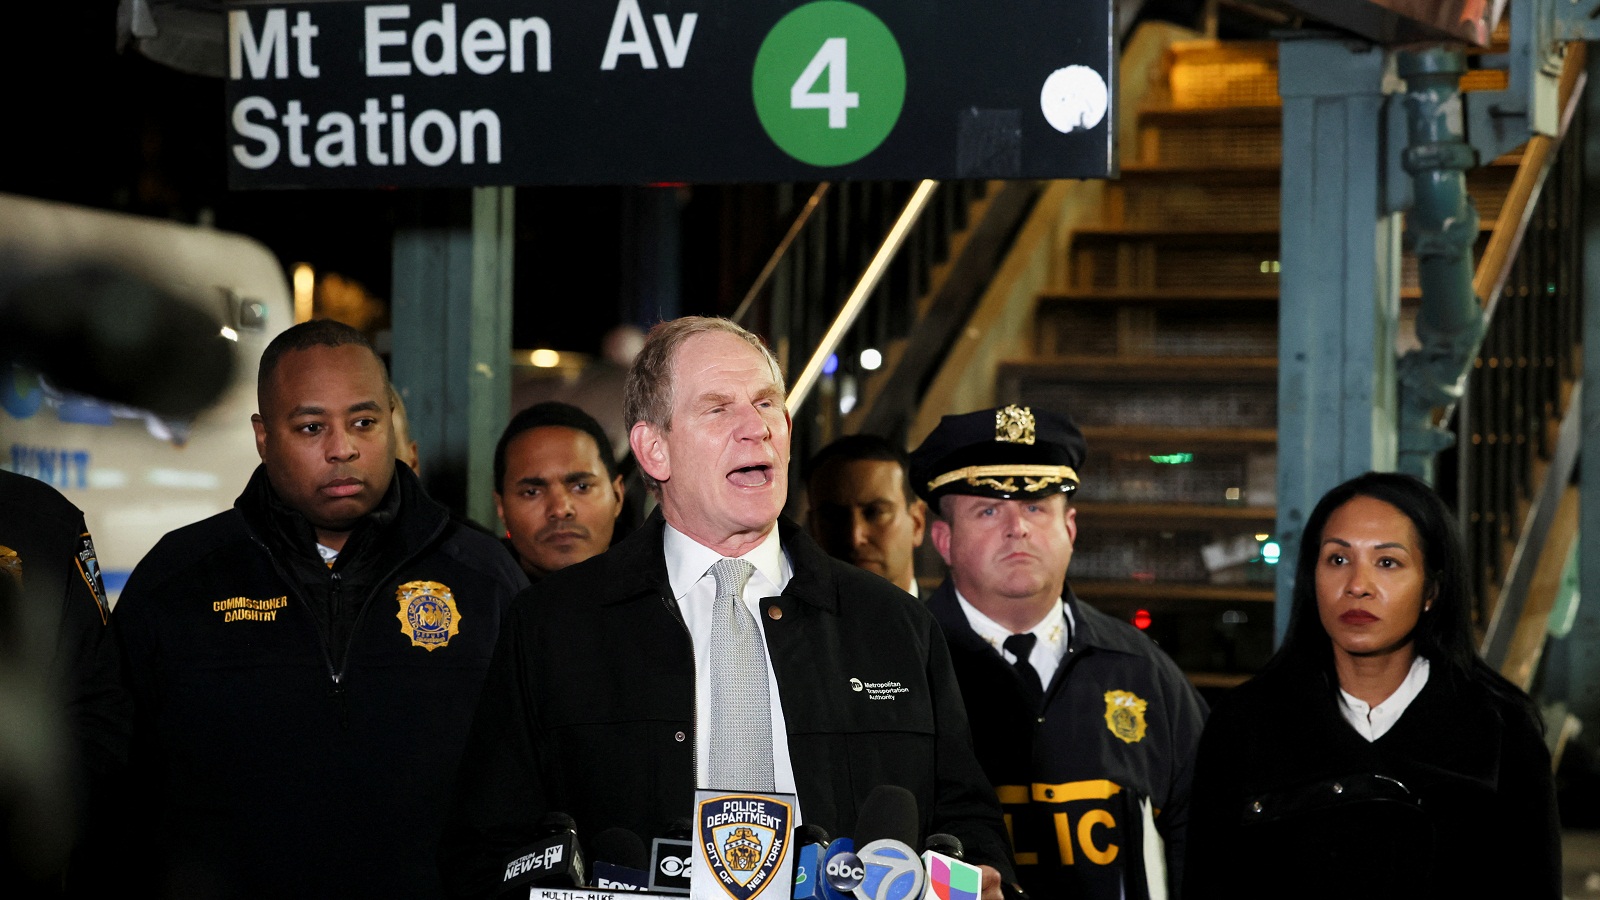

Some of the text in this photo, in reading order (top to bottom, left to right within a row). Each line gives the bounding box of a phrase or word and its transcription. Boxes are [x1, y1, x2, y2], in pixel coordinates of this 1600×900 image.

[228, 0, 698, 80] Mt Eden Av
[790, 37, 859, 129] 4
[231, 95, 501, 169] Station
[213, 596, 287, 611] COMMISSIONER
[224, 609, 277, 622] DAUGHTRY
[864, 680, 901, 688] Metropolitan
[869, 693, 895, 701] Authority
[723, 800, 765, 814] POLICE
[706, 812, 782, 830] DEPARTMENT
[503, 854, 544, 882] NEWS
[681, 857, 692, 878] 2
[706, 838, 783, 891] CITY OF NEW YORK
[826, 860, 864, 880] abc
